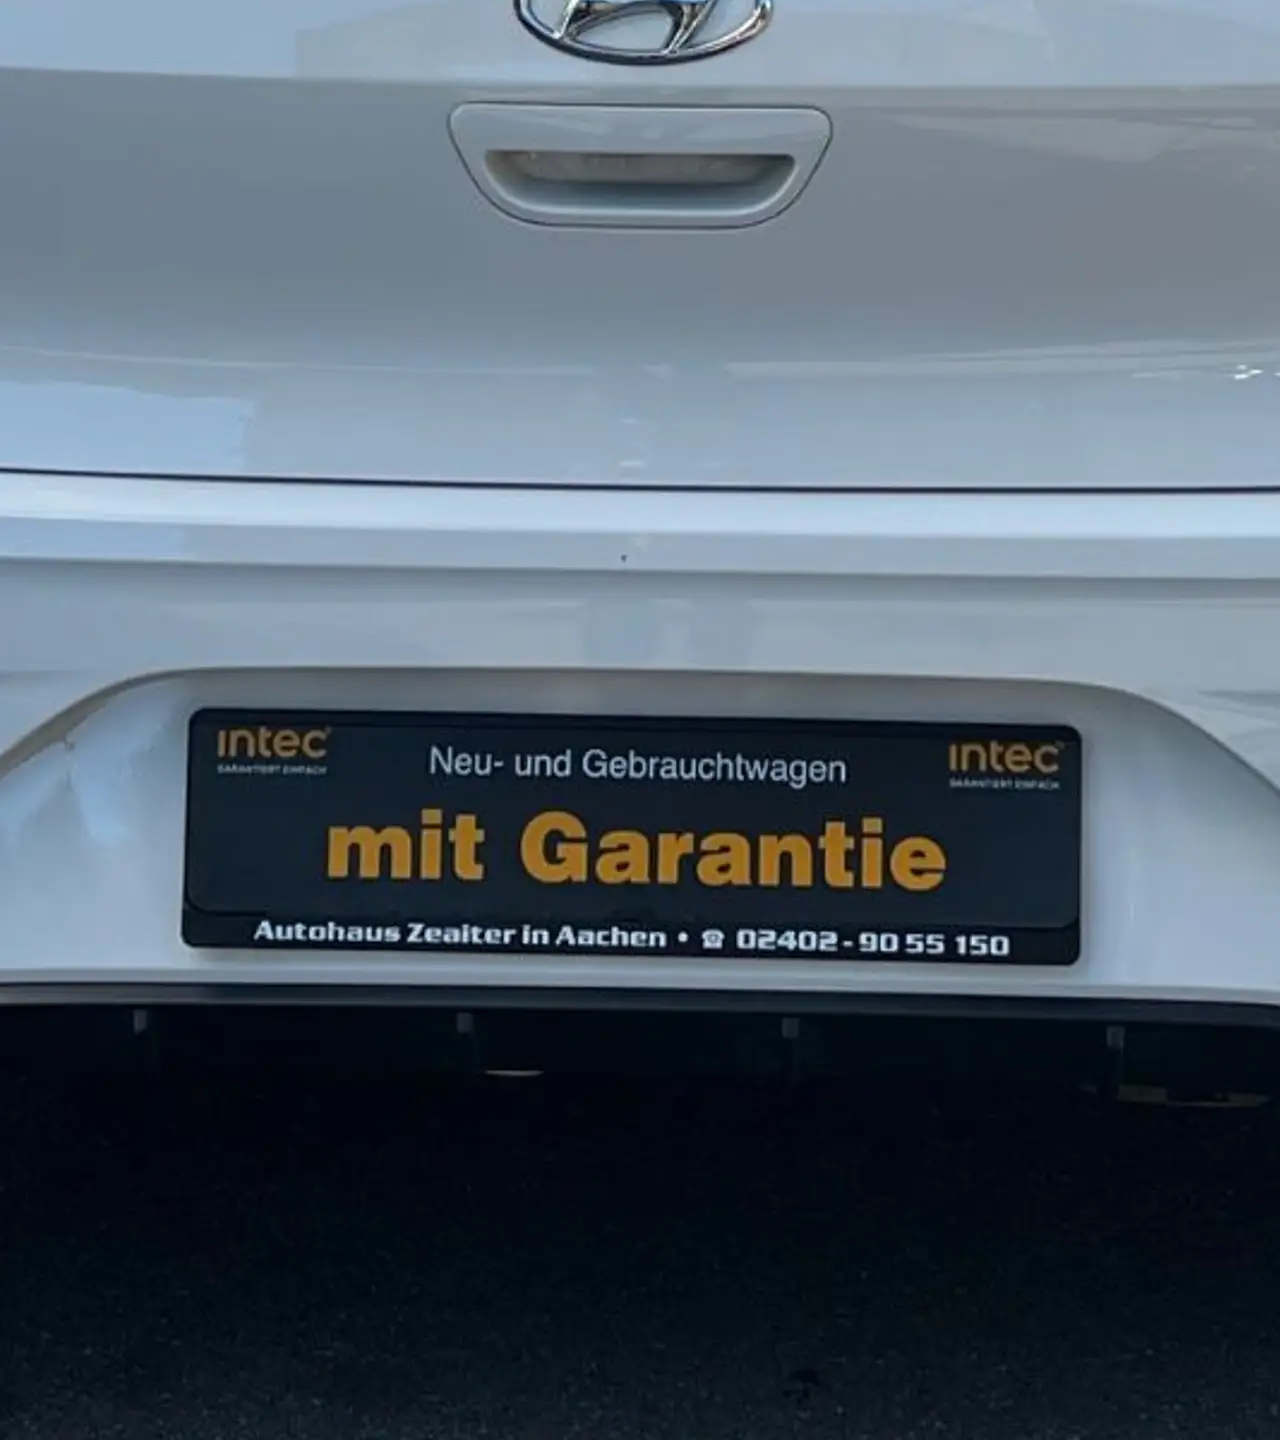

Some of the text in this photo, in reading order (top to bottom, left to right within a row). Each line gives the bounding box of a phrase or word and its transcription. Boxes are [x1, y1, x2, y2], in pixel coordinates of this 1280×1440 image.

[216, 725, 329, 759] intec
[948, 740, 1061, 774] intec
[429, 745, 847, 790] Neu- und Gebrauchtwagen
[327, 809, 947, 892] mit Garantie
[253, 920, 402, 943] Autohaus
[406, 922, 518, 945] Zeaiter
[521, 924, 550, 946] in
[555, 925, 667, 948] Aachen
[736, 928, 838, 952] 02402
[859, 932, 899, 953] 90
[904, 933, 945, 954] 55
[955, 935, 1010, 956] 150
